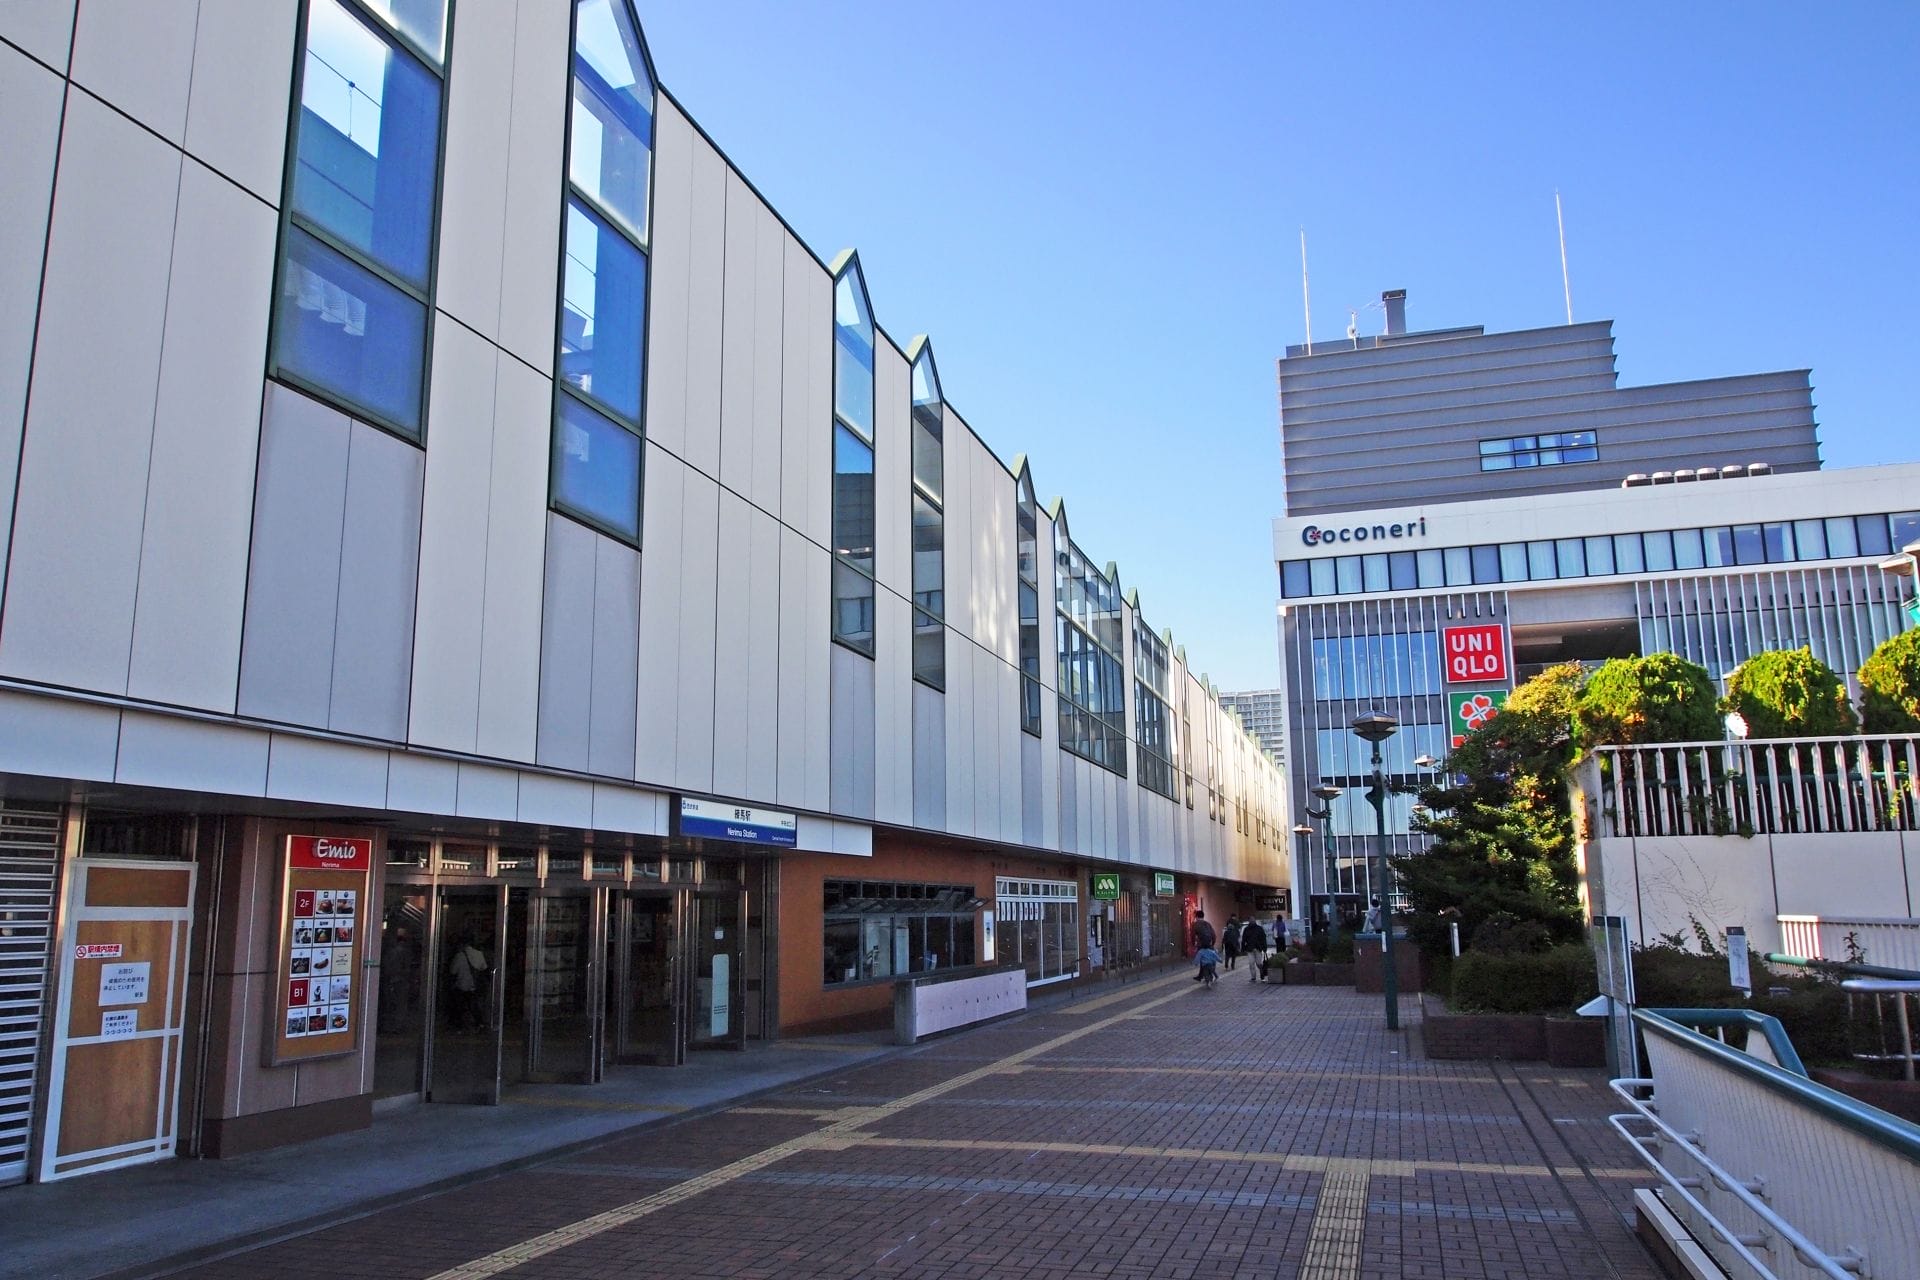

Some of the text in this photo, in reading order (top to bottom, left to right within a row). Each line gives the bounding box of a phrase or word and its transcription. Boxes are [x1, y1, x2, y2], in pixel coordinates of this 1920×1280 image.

[1302, 517, 1427, 547] Coconeri
[1452, 632, 1492, 652] UNI
[1453, 654, 1498, 677] QLO
[727, 827, 757, 839] Nerima Station
[317, 838, 356, 859] Emio
[299, 898, 310, 908] 2F
[294, 987, 304, 998] B1
